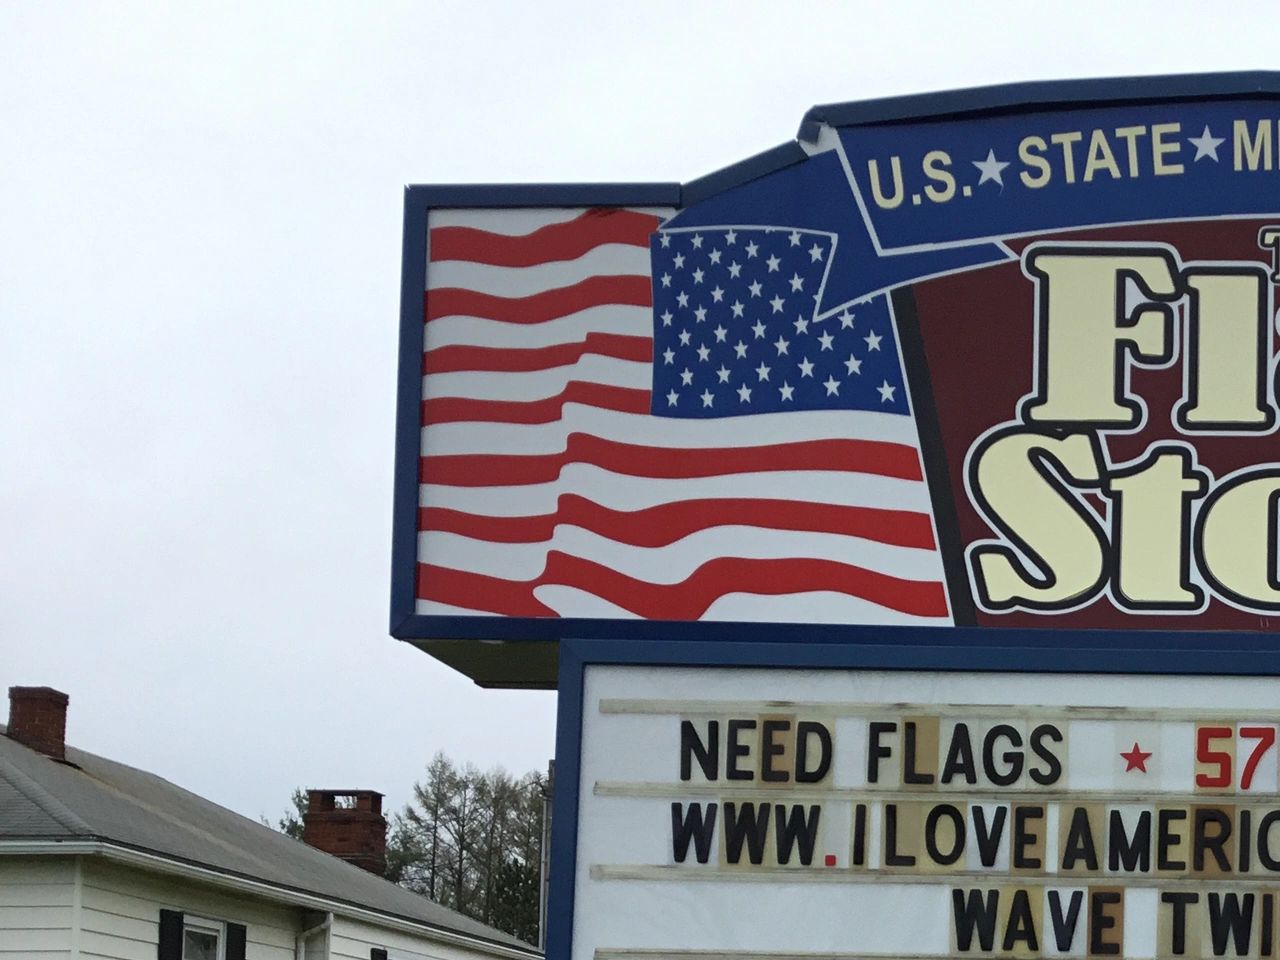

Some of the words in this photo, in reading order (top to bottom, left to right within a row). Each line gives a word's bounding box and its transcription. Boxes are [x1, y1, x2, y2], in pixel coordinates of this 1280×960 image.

[867, 150, 972, 210] U.S.
[1018, 122, 1185, 189] STATE
[680, 720, 833, 784] NEED
[867, 722, 1063, 786] FLAGS
[952, 888, 1121, 955] WAVE
